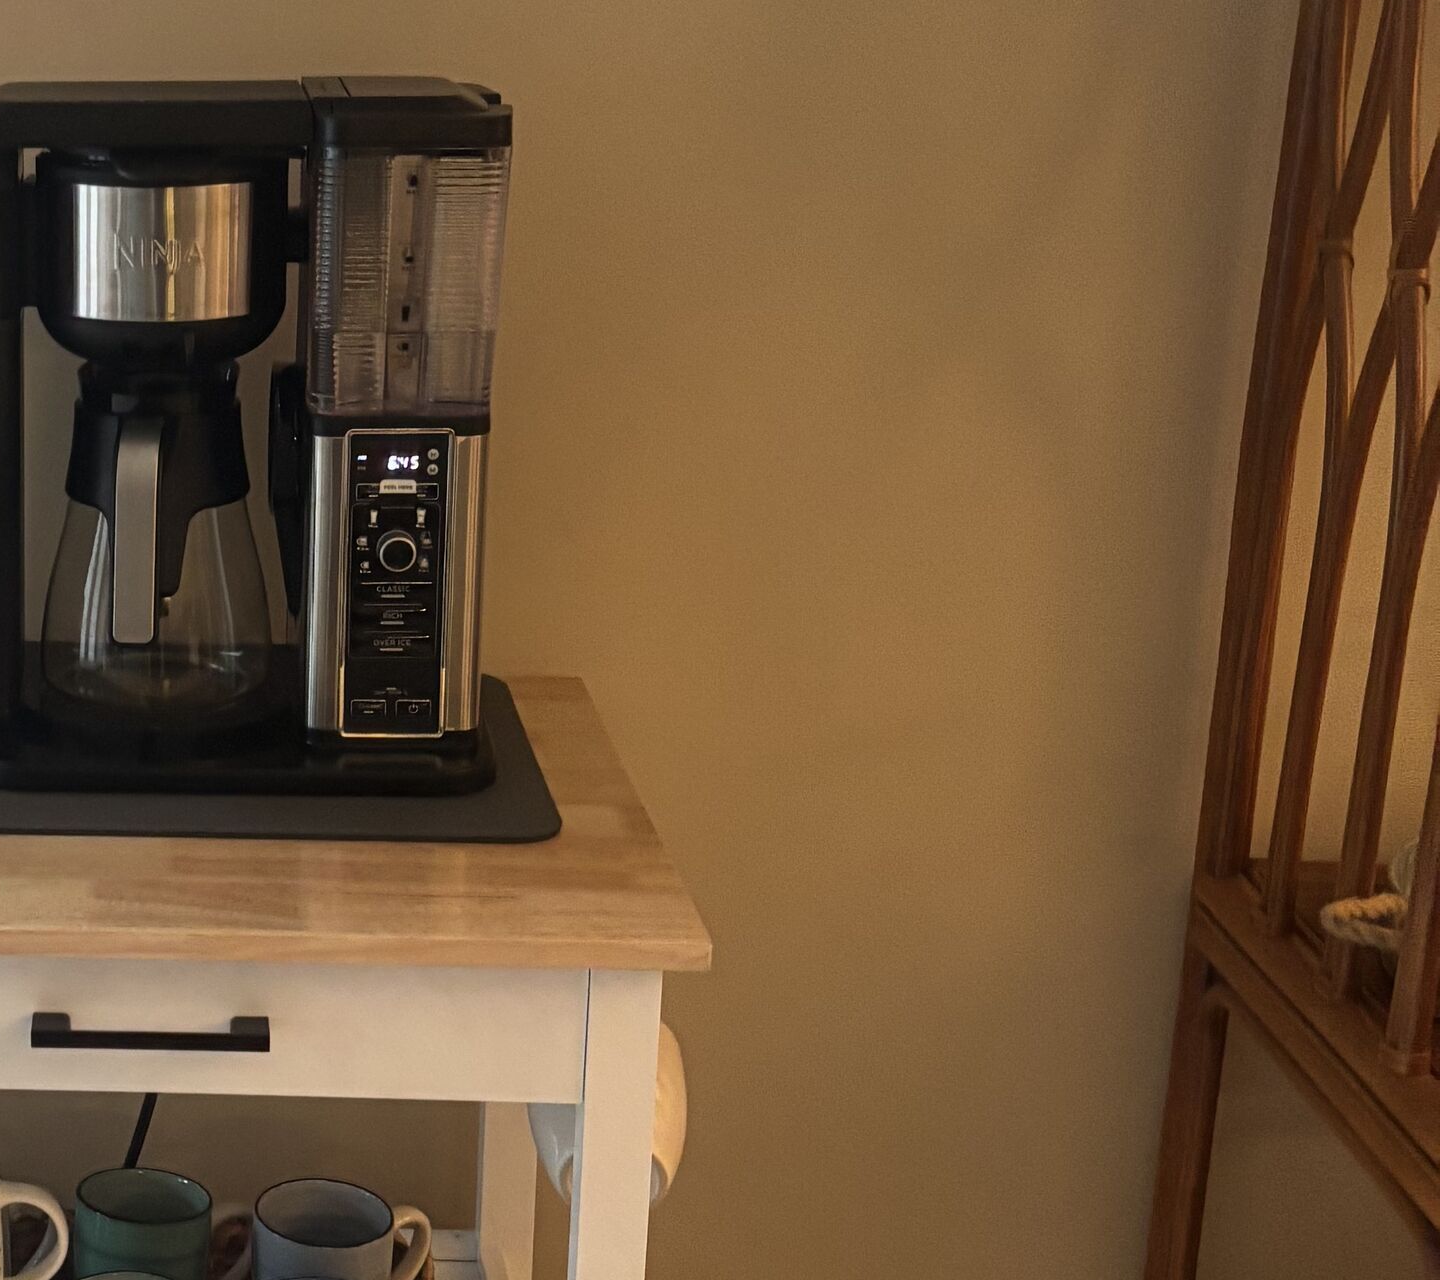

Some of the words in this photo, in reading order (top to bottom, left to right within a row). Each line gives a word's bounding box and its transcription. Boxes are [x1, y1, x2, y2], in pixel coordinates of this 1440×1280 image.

[113, 233, 206, 274] NINJA
[376, 585, 411, 593] CLASSIC
[373, 639, 397, 647] OVER
